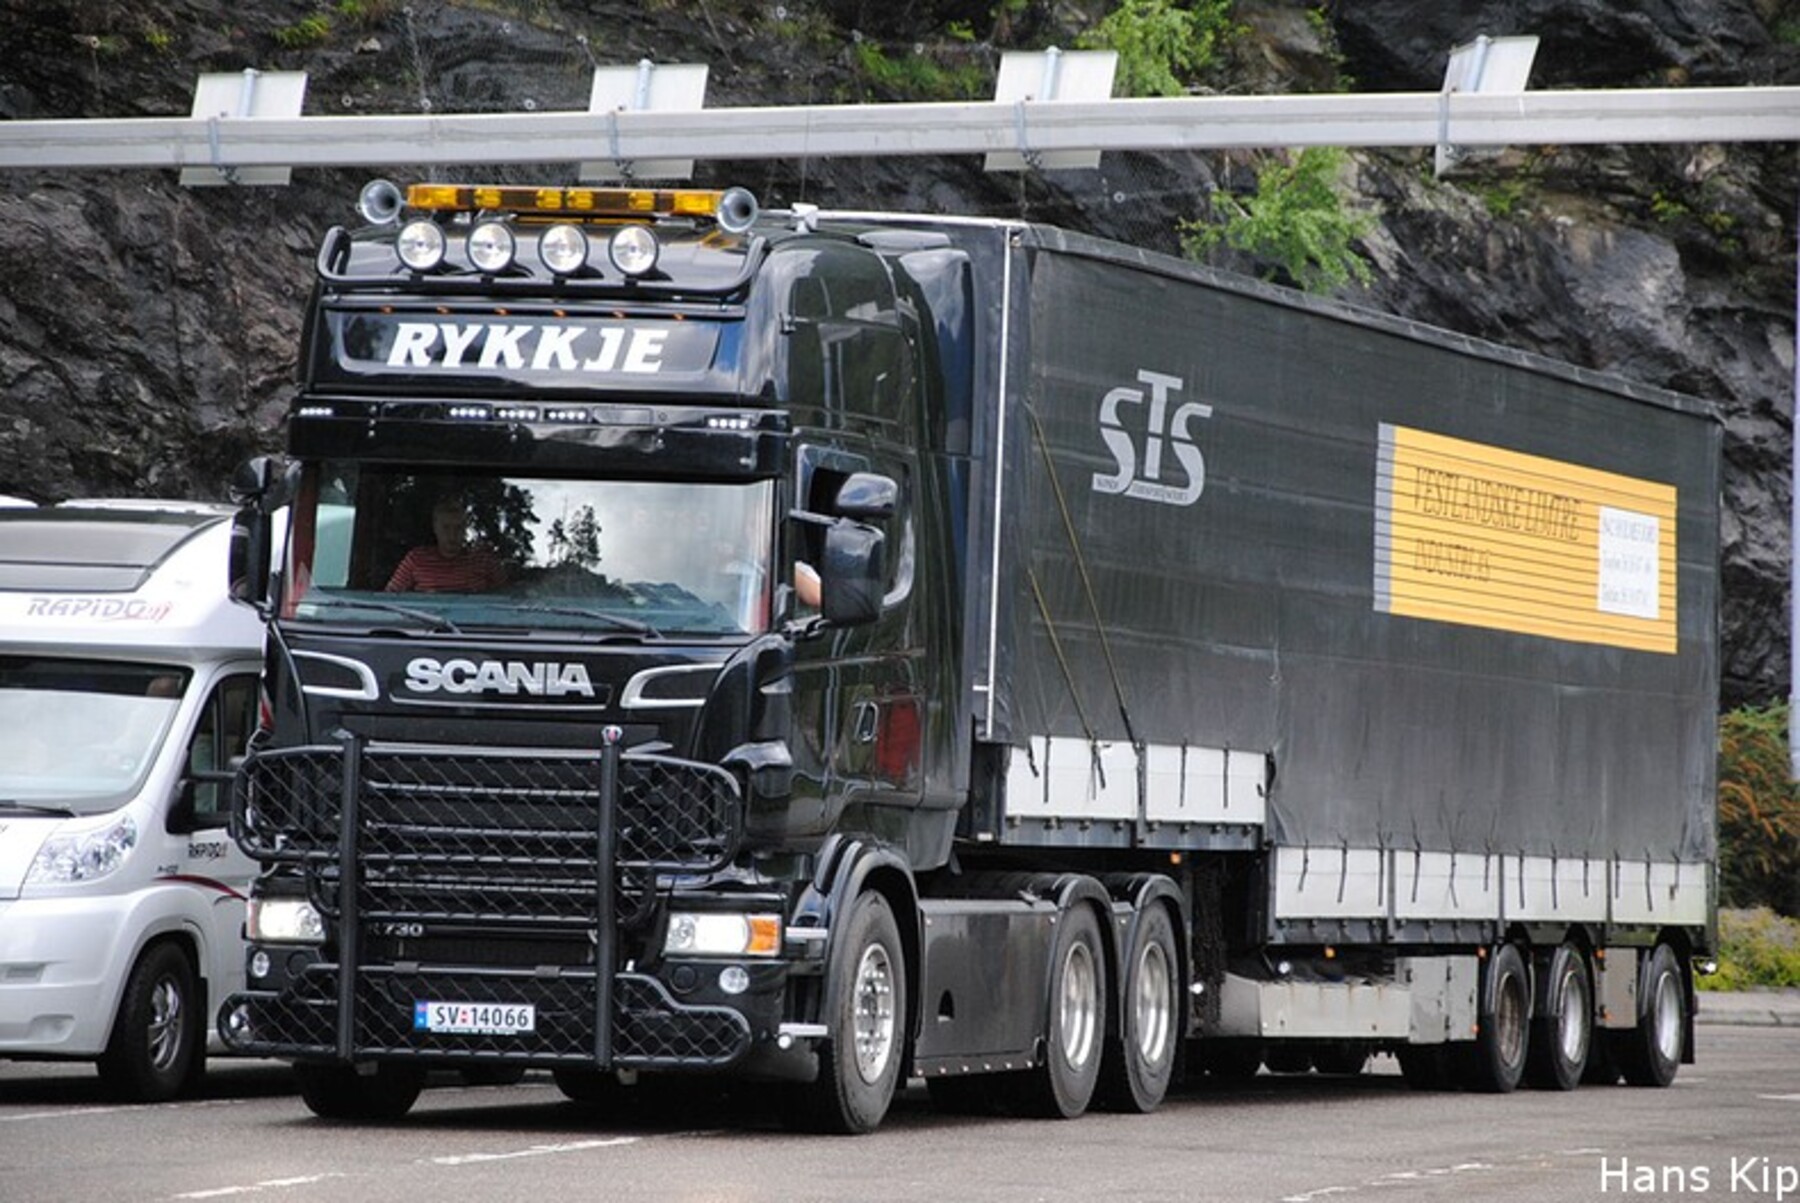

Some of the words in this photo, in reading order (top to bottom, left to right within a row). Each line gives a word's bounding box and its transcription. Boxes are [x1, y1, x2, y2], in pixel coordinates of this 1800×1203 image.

[386, 322, 667, 373] RYKKJE
[1091, 369, 1213, 505] STS
[405, 658, 594, 697] SCANIA
[470, 1007, 530, 1028] 14066
